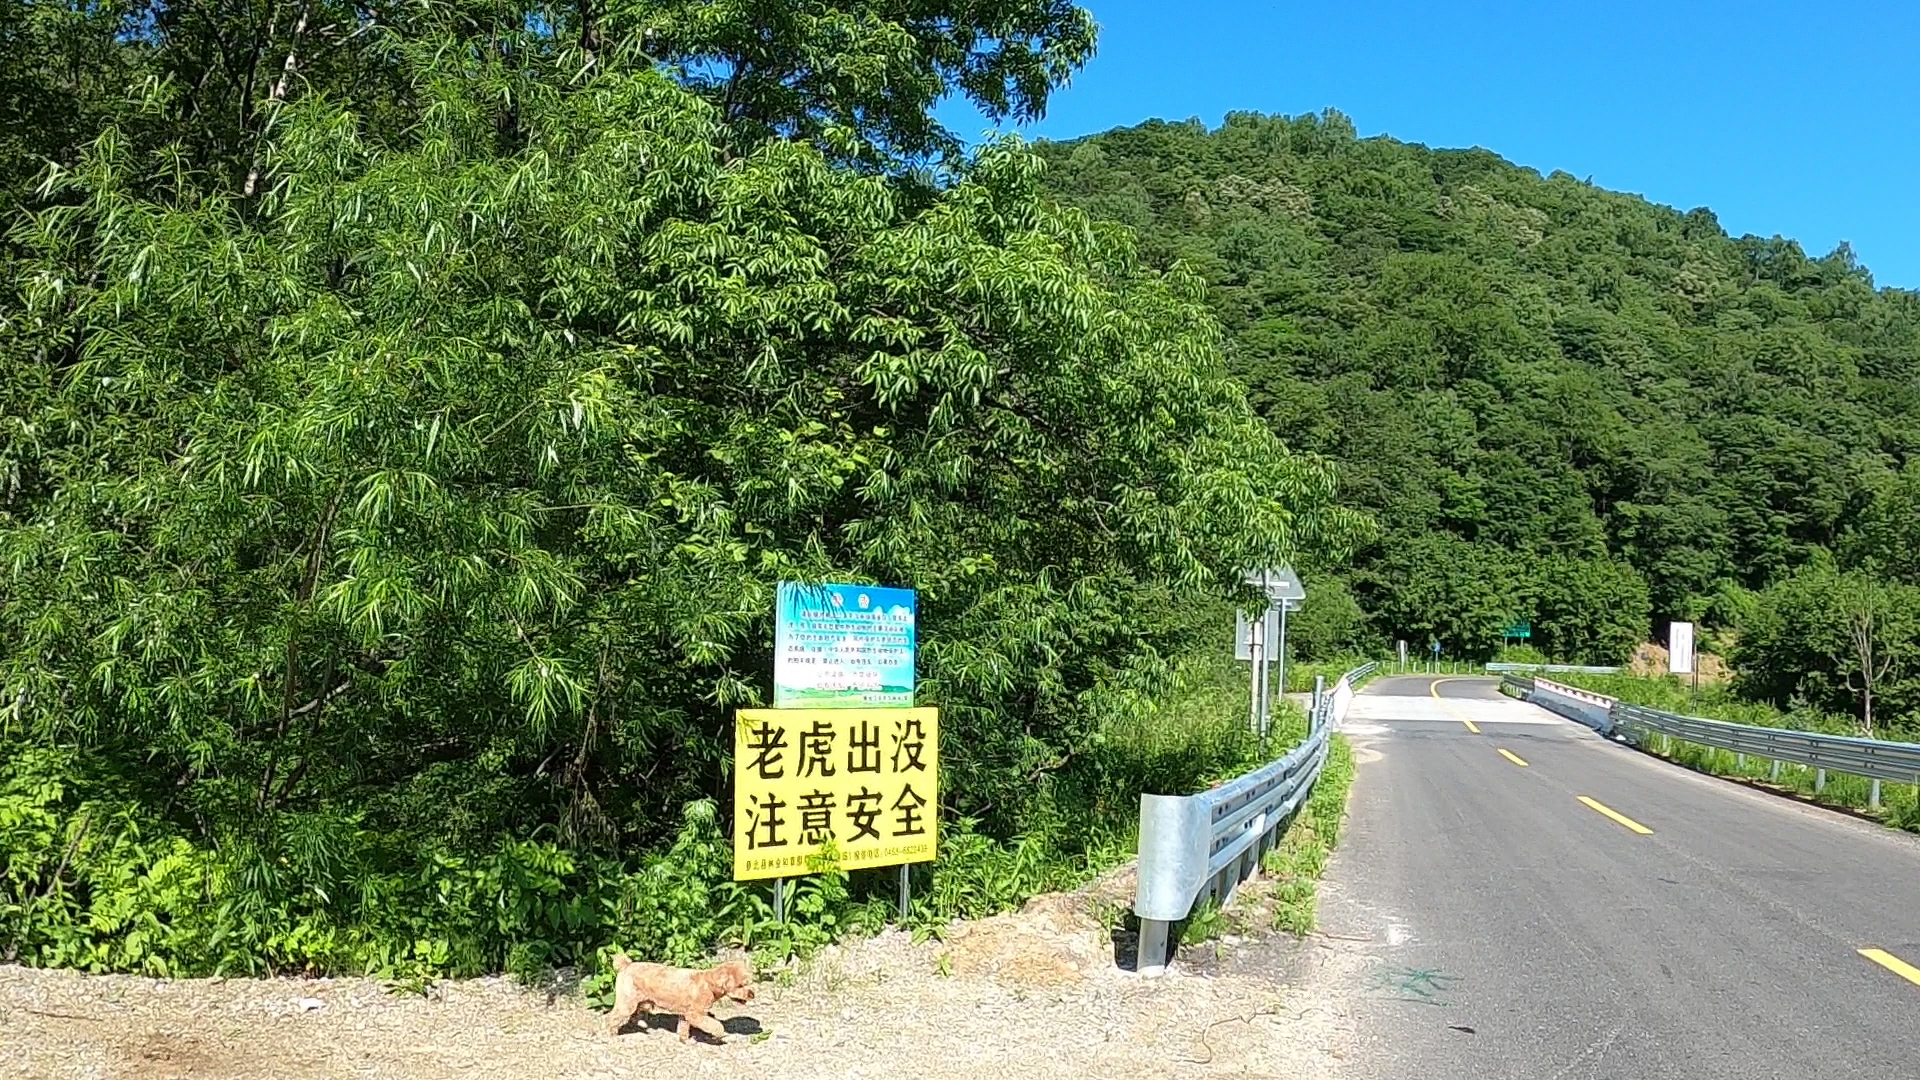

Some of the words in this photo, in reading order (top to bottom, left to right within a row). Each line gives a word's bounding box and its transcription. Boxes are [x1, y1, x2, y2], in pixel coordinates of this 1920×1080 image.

[746, 719, 927, 779] 老虎出没
[745, 783, 927, 850] 注意安全
